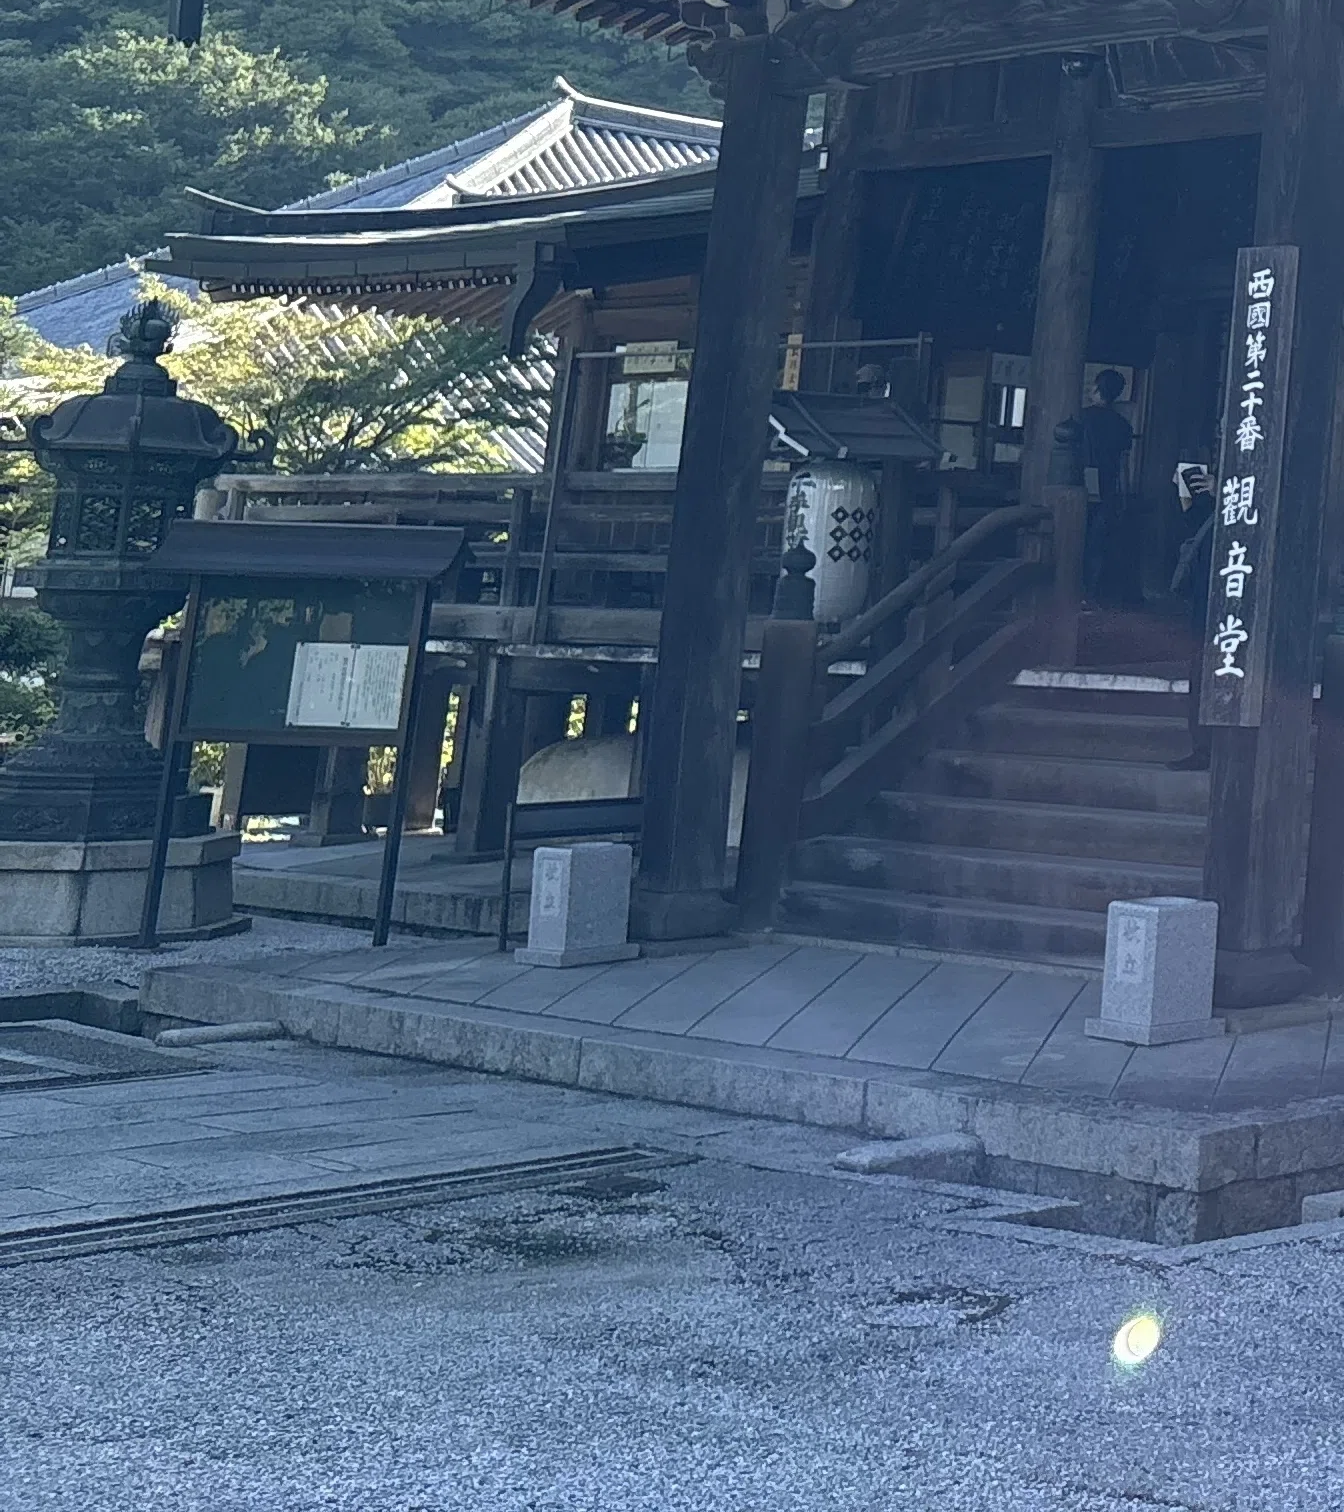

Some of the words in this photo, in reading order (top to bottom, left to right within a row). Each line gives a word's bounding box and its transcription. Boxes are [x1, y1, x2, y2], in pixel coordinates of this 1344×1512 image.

[1234, 267, 1276, 453] 西國第二十番
[1212, 474, 1259, 679] 觀音堂
